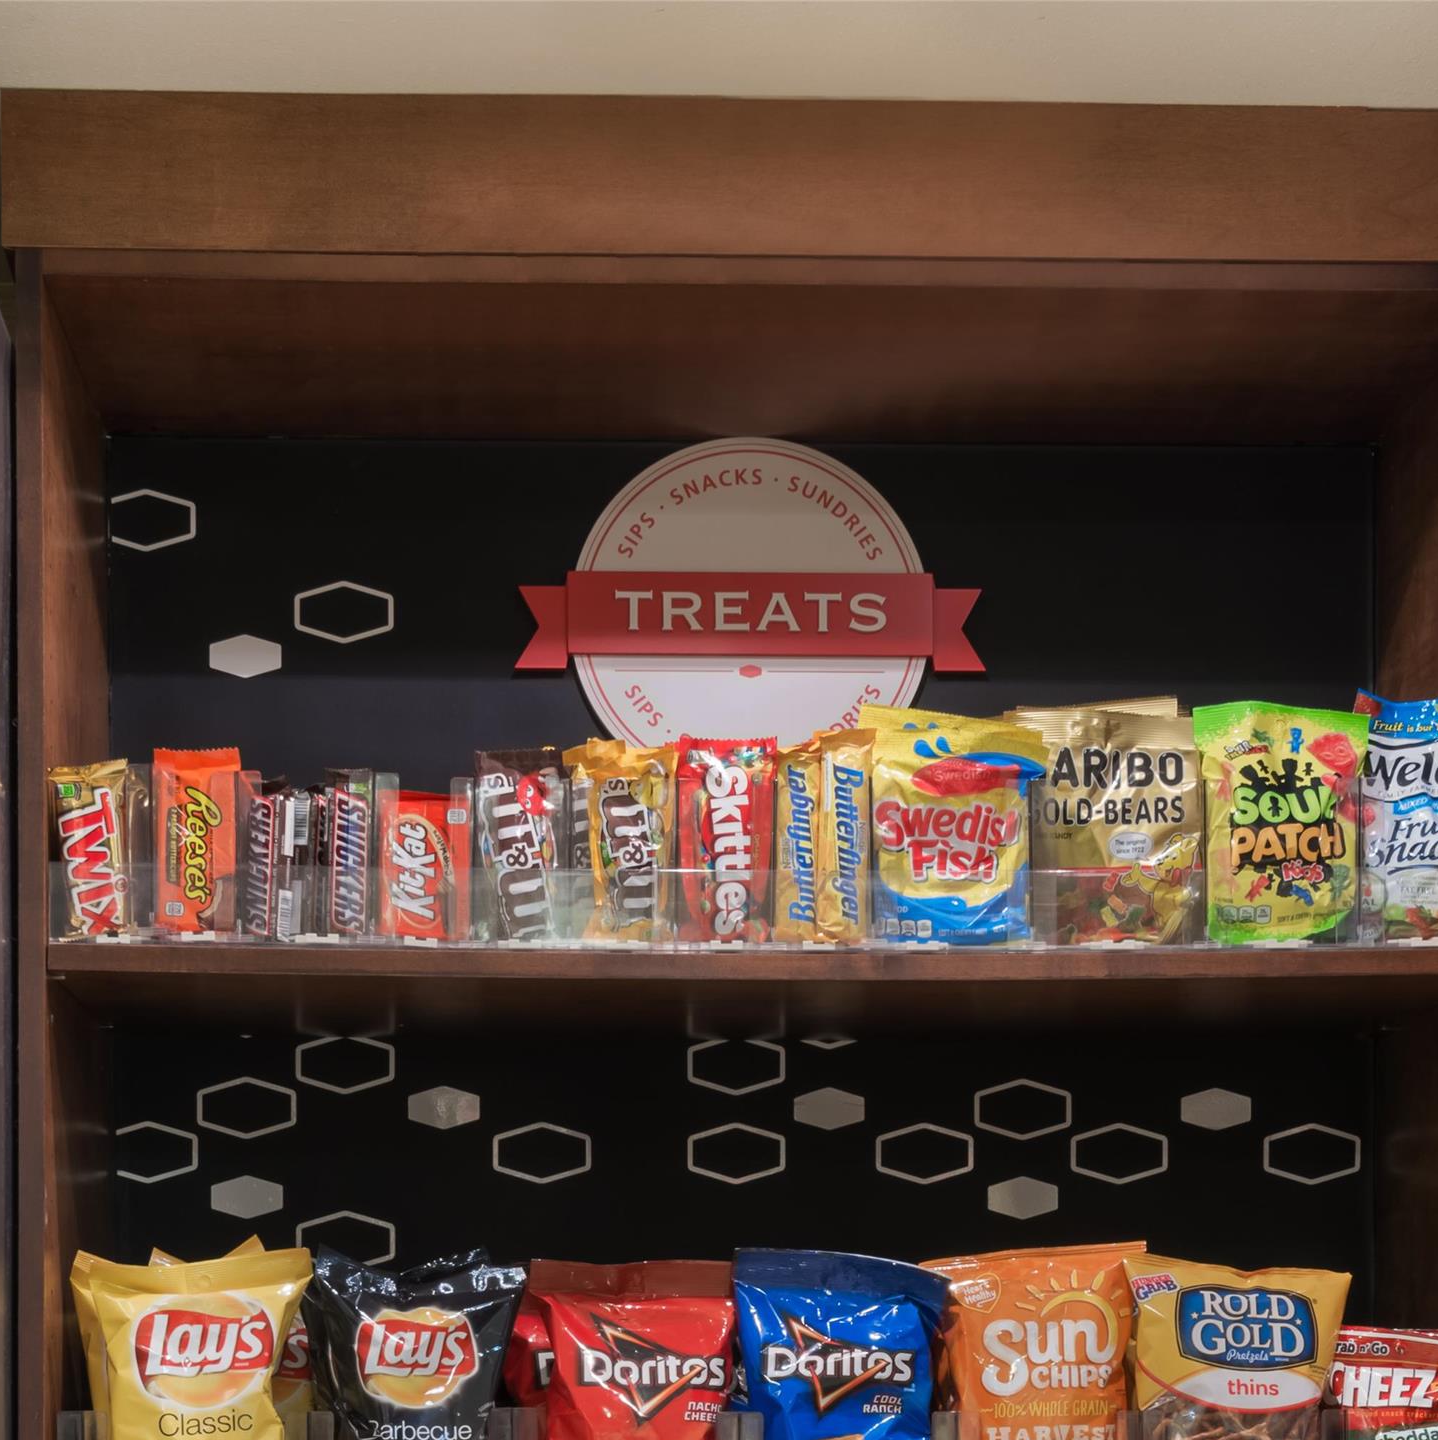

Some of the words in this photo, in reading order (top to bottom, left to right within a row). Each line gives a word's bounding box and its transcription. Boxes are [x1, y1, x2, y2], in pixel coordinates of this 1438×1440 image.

[617, 511, 657, 560] SIPS
[669, 467, 763, 506] SNACKS
[787, 475, 884, 562] SUNDRIES
[614, 589, 888, 634] TREATS
[624, 684, 663, 728] SIPS
[1374, 720, 1404, 734] Fruit
[1050, 747, 1184, 790] ARIBO
[60, 788, 129, 935] TWIX
[185, 786, 223, 904] Reese's
[333, 796, 369, 930] SNICKERS
[788, 762, 816, 924] Butterfinger
[833, 764, 862, 925] Butterfinger
[907, 839, 999, 884] Fish
[1231, 823, 1346, 867] PATCH
[1200, 1290, 1296, 1321] ROLD
[145, 1313, 265, 1377] Lay's
[364, 1320, 469, 1379] Lay's
[1191, 1318, 1306, 1358] GOLD
[1226, 1348, 1269, 1363] Pretzels
[1335, 1342, 1356, 1354] rab
[1371, 1342, 1389, 1355] Go
[581, 1347, 725, 1387] Doritos
[766, 1347, 914, 1382] Doritos
[1030, 1364, 1113, 1390] CHIPS
[874, 1393, 903, 1406] COOL
[1227, 1378, 1280, 1397] thins
[158, 1408, 253, 1438] Classic
[863, 1404, 903, 1415] RANCH
[993, 1402, 1028, 1419] 100%
[1029, 1400, 1070, 1418] WHOLE
[1073, 1400, 1109, 1417] GRAIN
